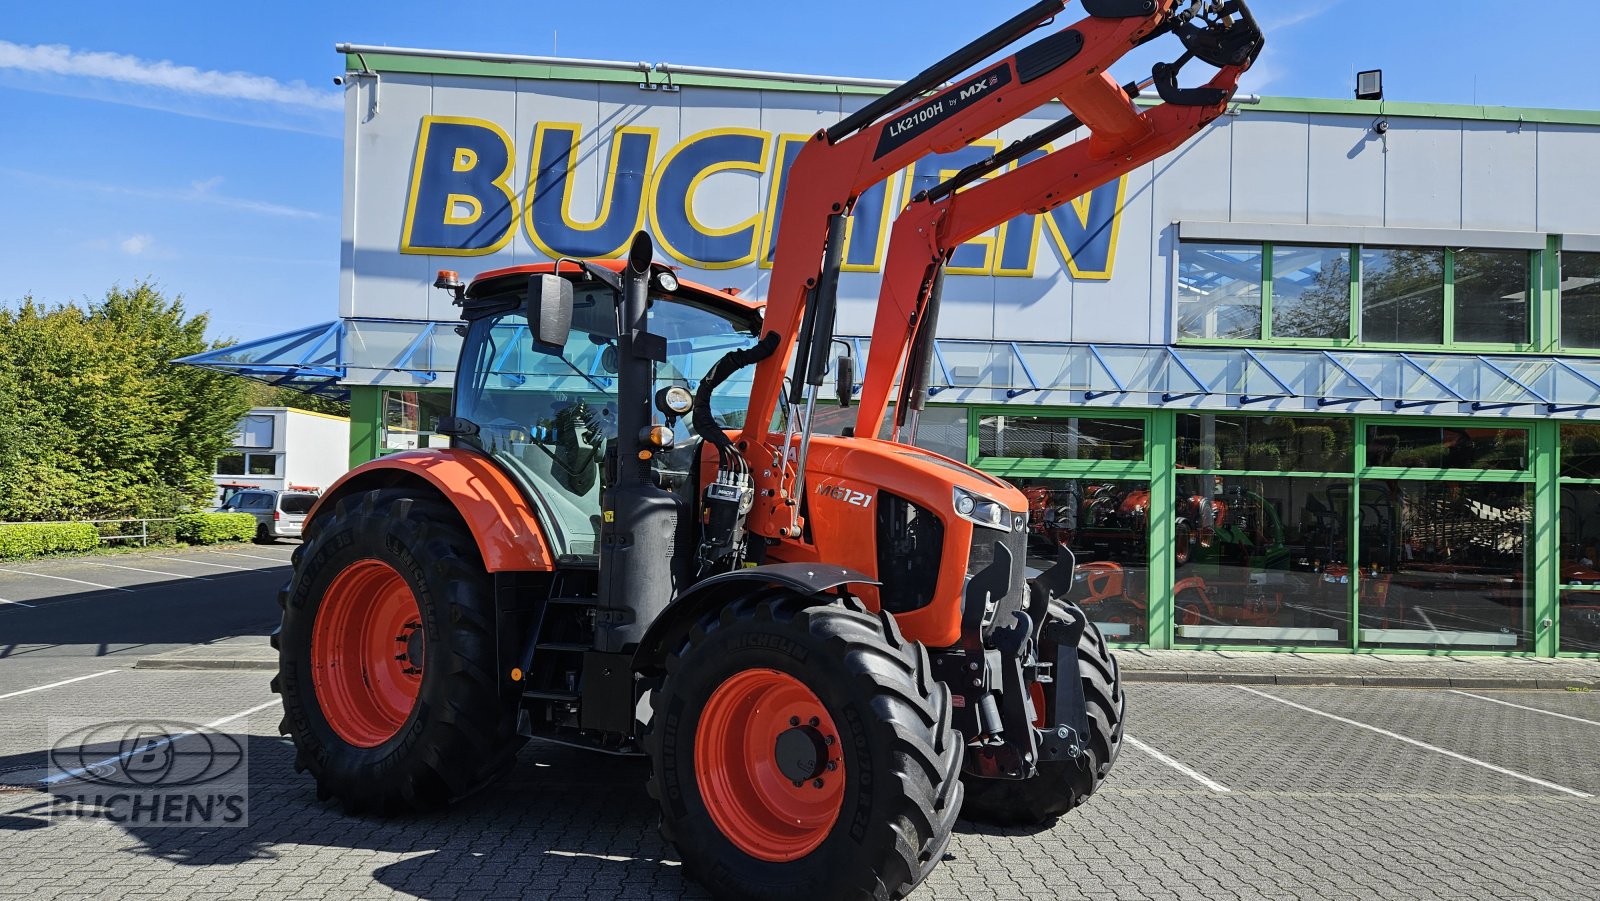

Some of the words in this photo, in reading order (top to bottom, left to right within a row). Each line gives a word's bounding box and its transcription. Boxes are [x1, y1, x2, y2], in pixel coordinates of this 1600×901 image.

[890, 102, 944, 137] LK2100H
[949, 97, 957, 106] by
[960, 79, 988, 100] MX
[815, 482, 873, 508] M6121
